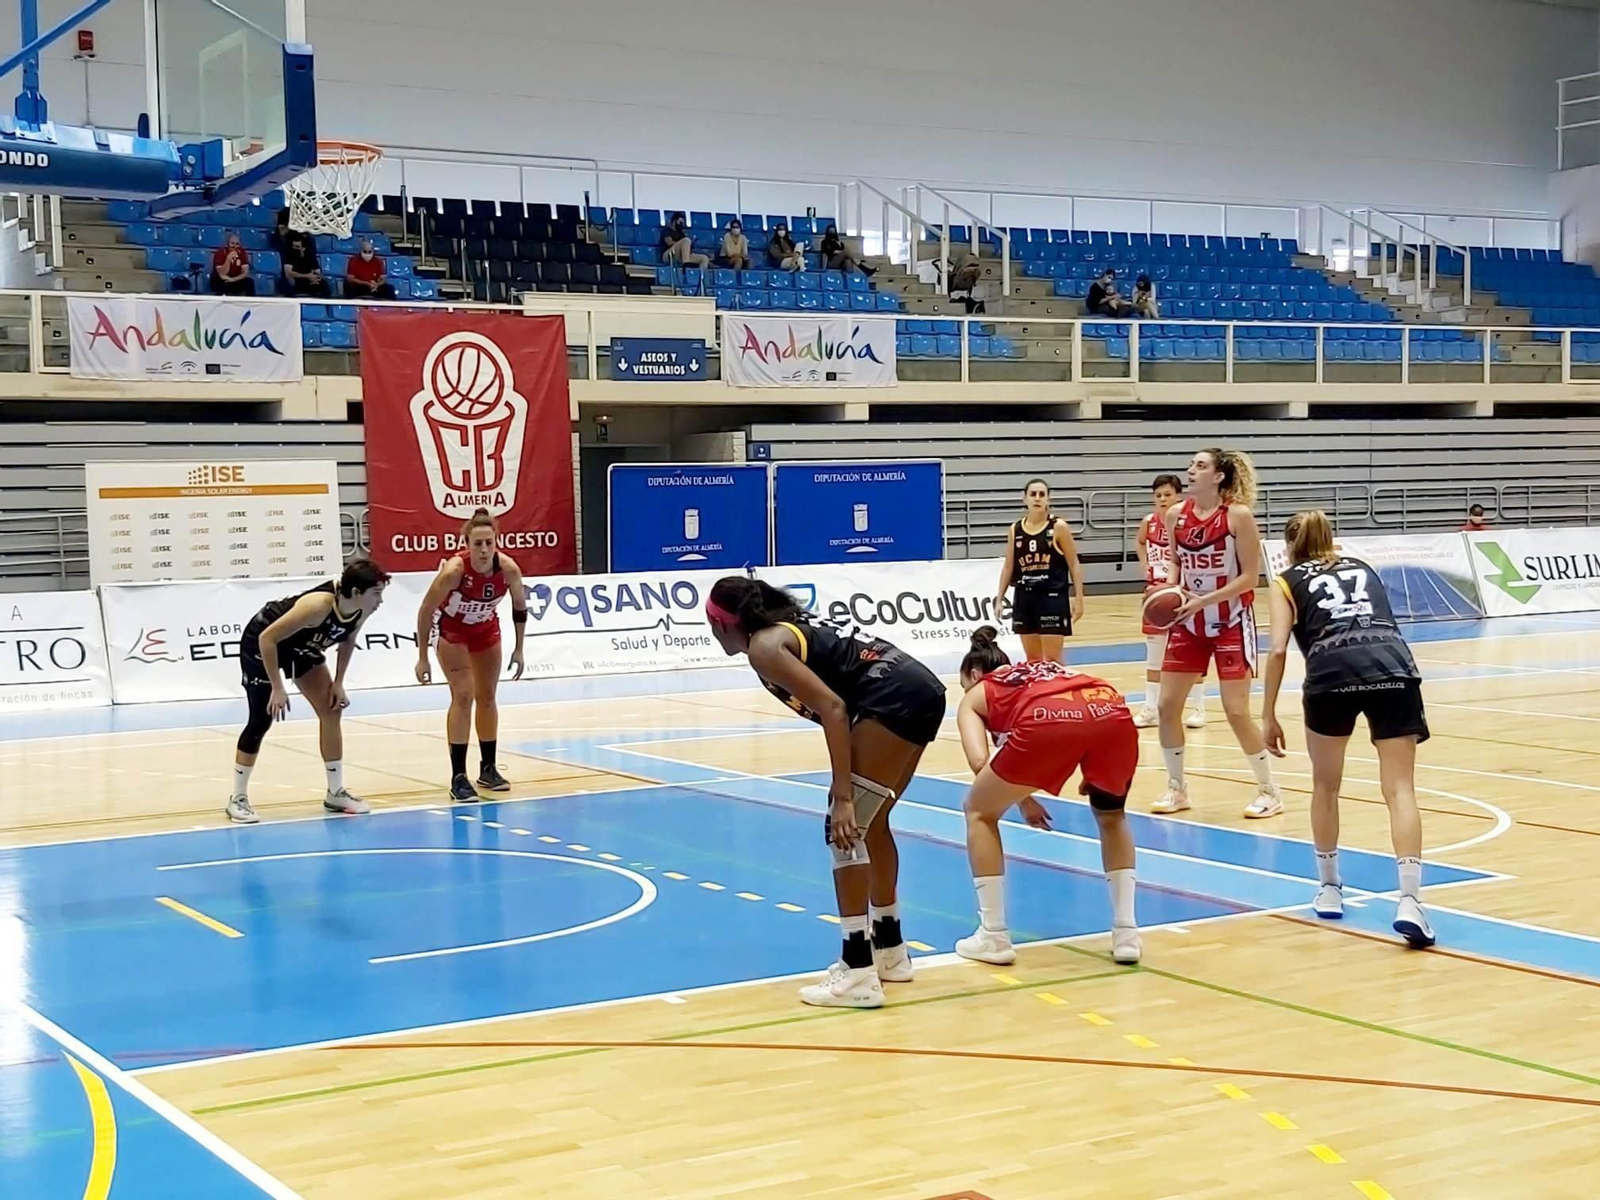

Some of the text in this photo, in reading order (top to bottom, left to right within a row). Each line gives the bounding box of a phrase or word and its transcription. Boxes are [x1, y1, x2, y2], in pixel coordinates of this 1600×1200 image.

[84, 304, 286, 356] Andalucía
[738, 323, 885, 365] Andalucía
[641, 352, 677, 363] ASEOS Y
[632, 365, 686, 375] VESTUARIOS
[211, 465, 246, 483] ISE
[648, 474, 735, 486] DIPUTACIÓN DE ALMERÍA
[814, 471, 907, 483] DIPUTACIÓN DE ALMERÍA
[442, 492, 507, 508] ALMERIA
[391, 531, 558, 552] CLUB BANCESTO
[1186, 526, 1206, 544] 14
[1028, 540, 1037, 552] 8
[1018, 553, 1051, 566] UCAM
[1191, 552, 1225, 569] ISE
[483, 582, 495, 599] 6
[1308, 569, 1370, 609] 37
[11, 604, 23, 621] A
[828, 590, 1013, 625] eCoCulture
[611, 634, 711, 652] Salud y Deporte
[911, 629, 951, 640] Stress
[1033, 707, 1083, 721] Divina
